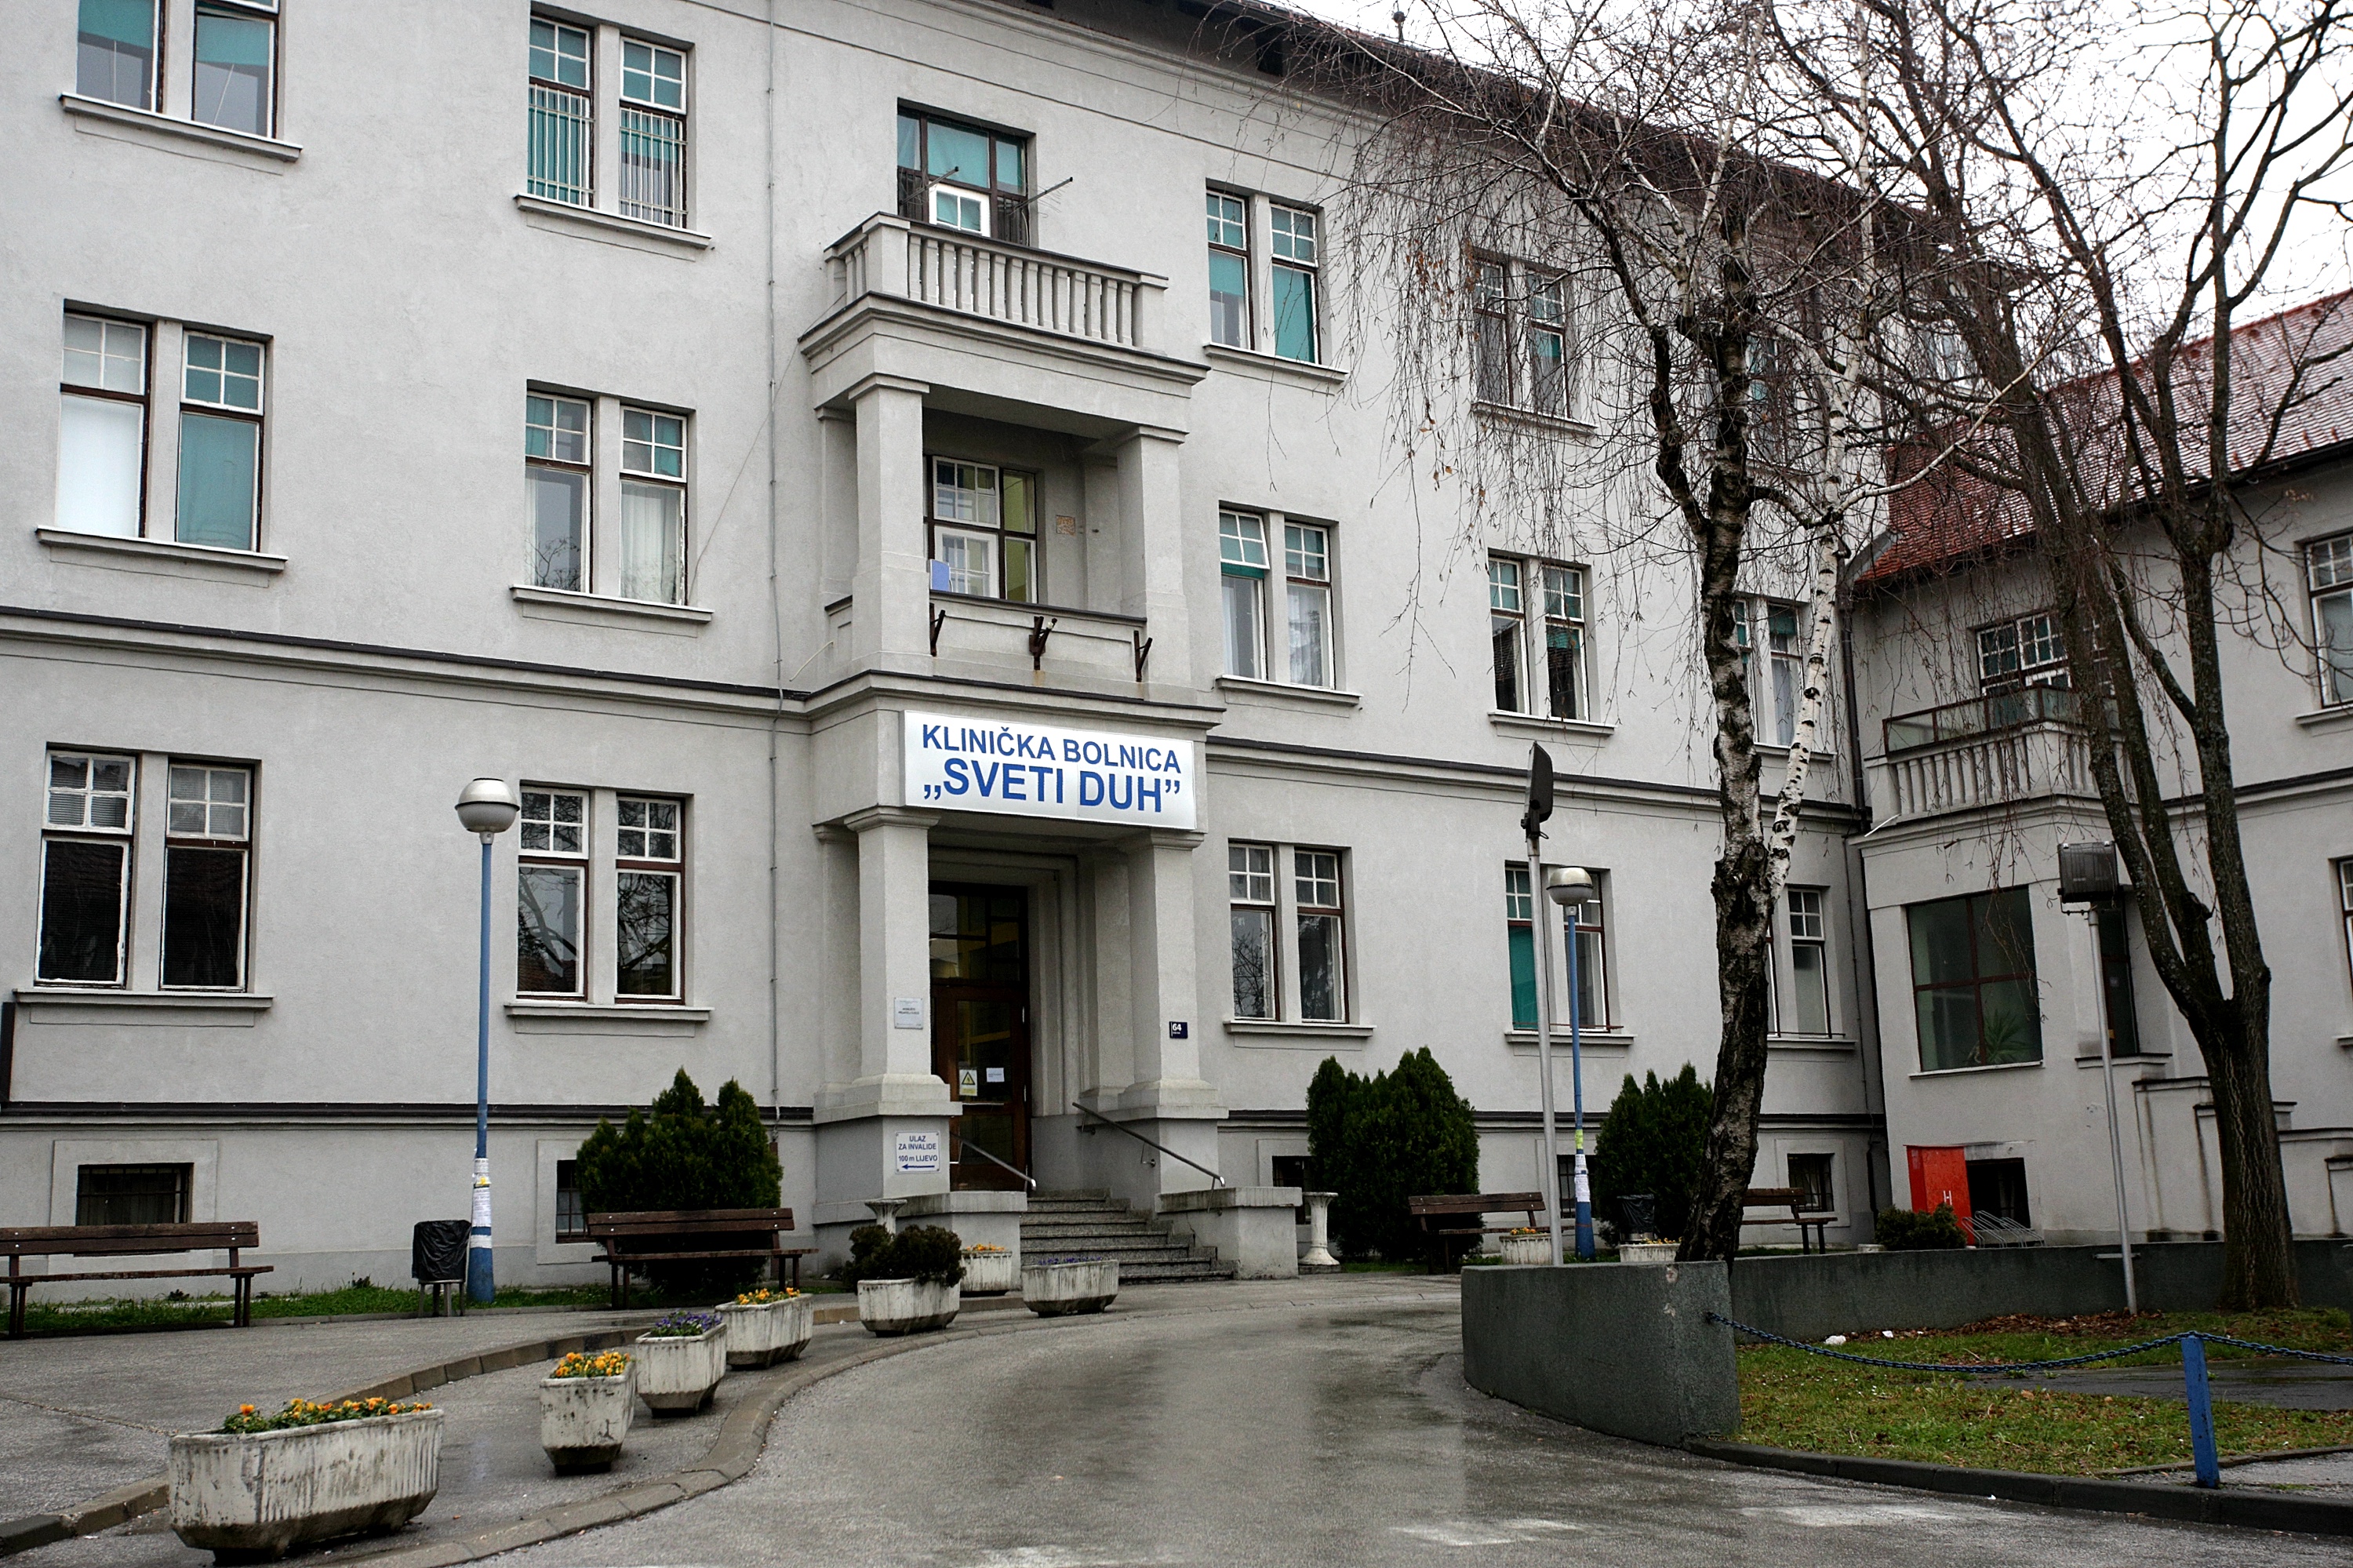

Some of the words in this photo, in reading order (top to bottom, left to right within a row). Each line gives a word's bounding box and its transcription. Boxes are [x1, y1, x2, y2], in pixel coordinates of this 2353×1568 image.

[922, 724, 1056, 761] KLINIČKA
[1063, 738, 1182, 774] BOLNICA
[1173, 1023, 1181, 1031] 64
